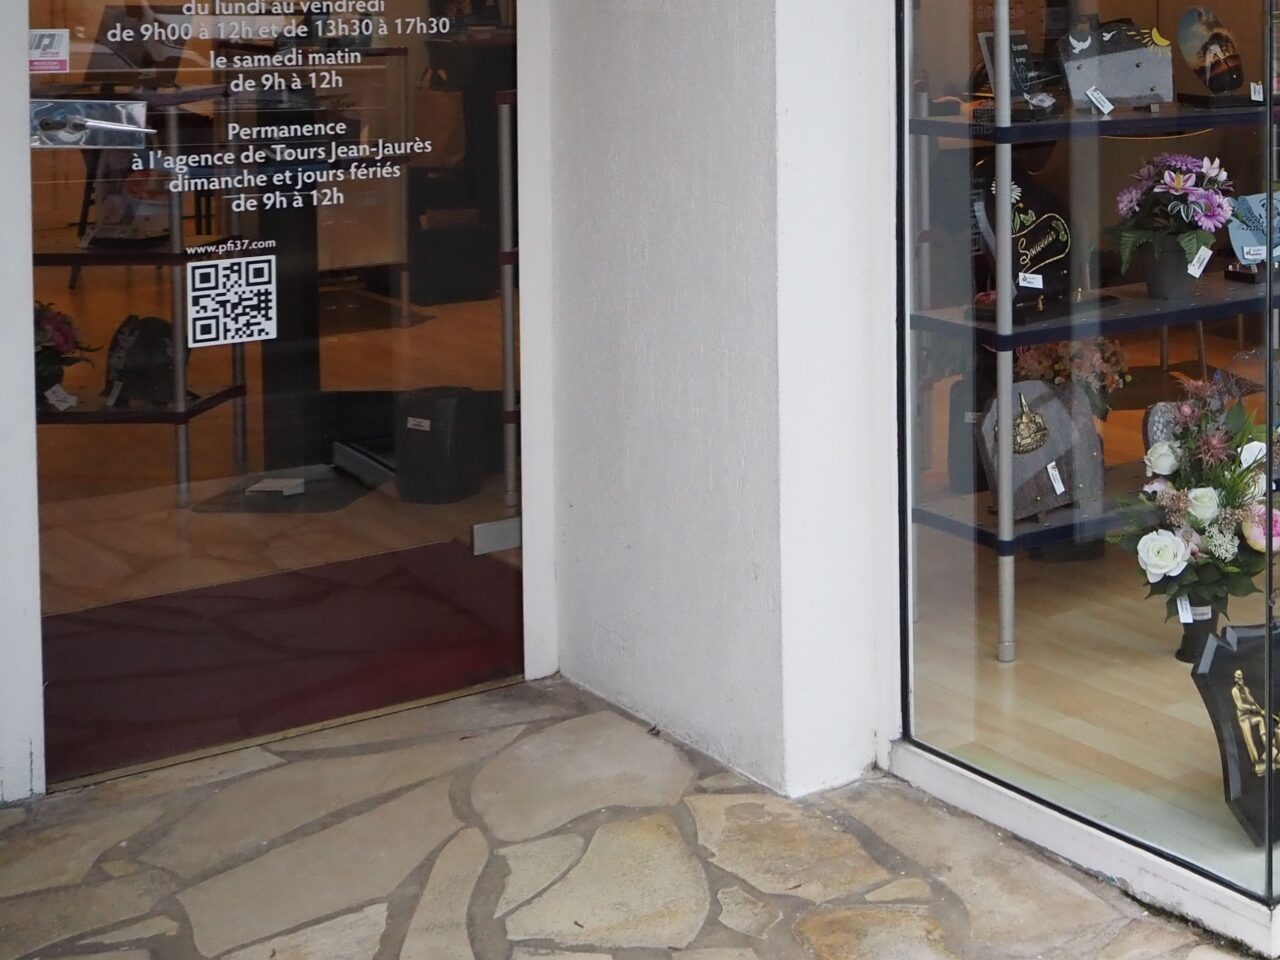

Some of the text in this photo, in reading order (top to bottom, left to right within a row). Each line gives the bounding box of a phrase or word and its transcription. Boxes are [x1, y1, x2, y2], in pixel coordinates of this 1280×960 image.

[271, 2, 295, 14] au
[107, 17, 450, 42] de 9h00 à 12h et de 13h30 à 17h30
[210, 48, 362, 69] le samedi matin
[230, 71, 343, 92] de 9h à 12h
[227, 120, 347, 140] Permanence
[132, 137, 432, 173] à l'agence de Tours Jean-Jaurès
[169, 162, 400, 193] dimanche et jours fériés
[232, 188, 344, 213] de 9h à 12h
[186, 238, 276, 256] www.pfi37.com
